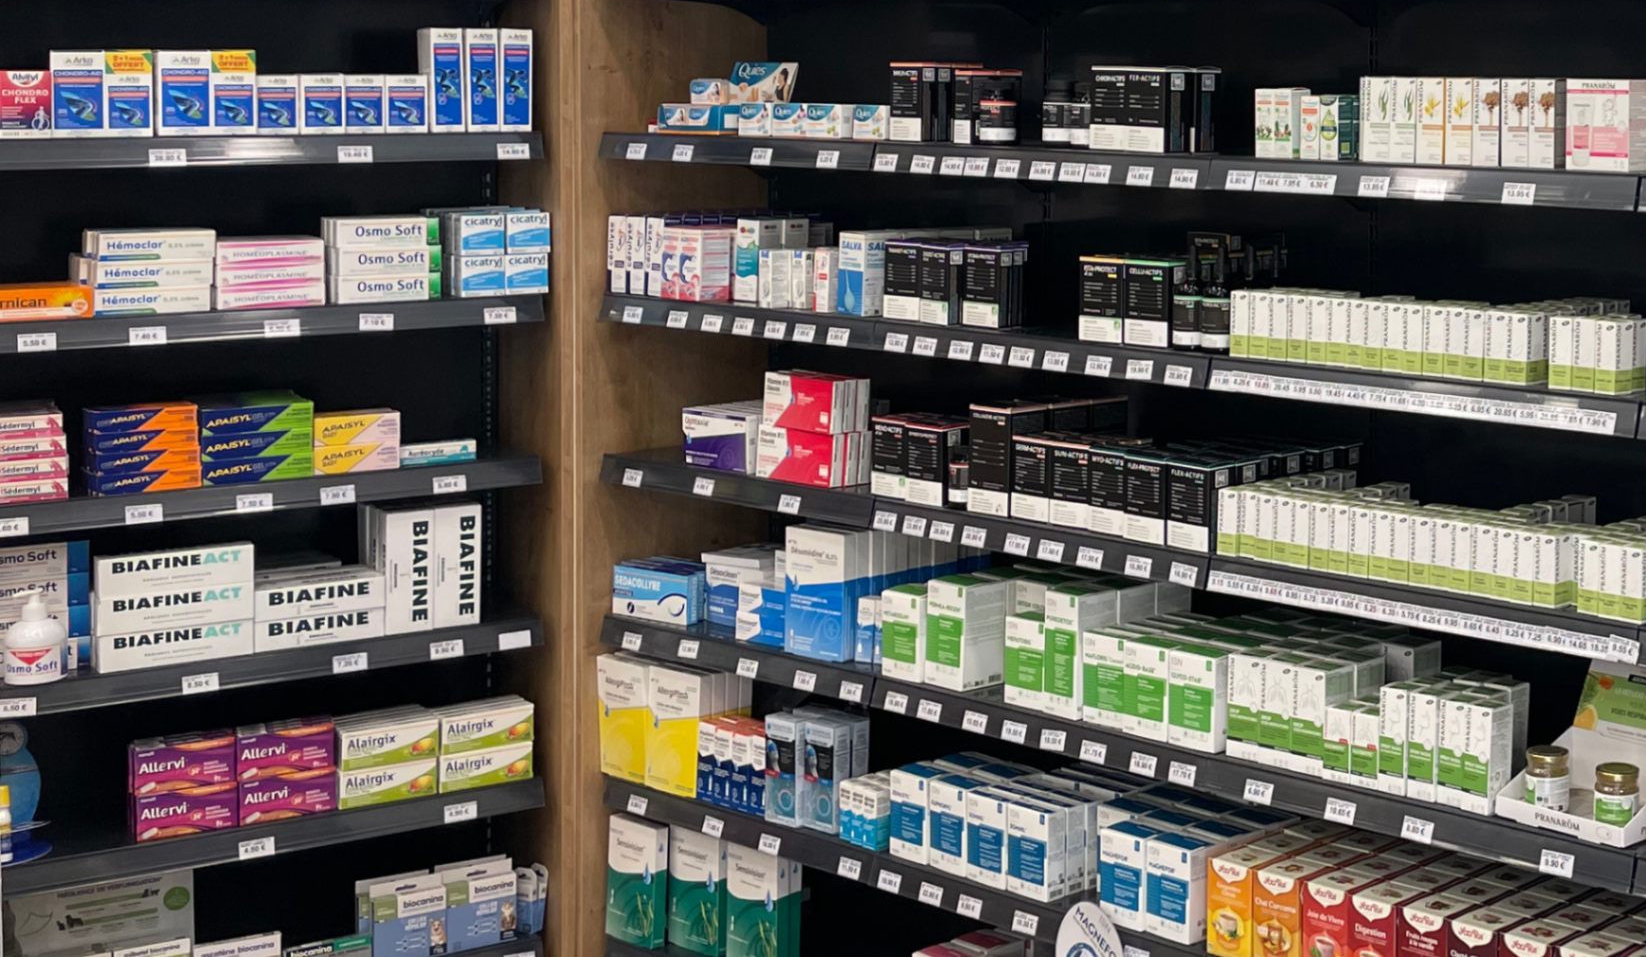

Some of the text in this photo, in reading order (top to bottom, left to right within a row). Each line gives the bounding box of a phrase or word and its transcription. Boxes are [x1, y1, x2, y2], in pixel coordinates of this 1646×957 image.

[355, 224, 422, 237] Osmo Soft
[107, 240, 163, 250] Hémoclar
[357, 279, 424, 292] Osmo Soft
[102, 295, 159, 306] Hémoclar
[207, 414, 251, 428] APAISYL
[207, 464, 252, 478] APAISYL
[412, 520, 429, 623] BIAFINE
[459, 515, 476, 616] BIAFINE
[268, 581, 370, 606] BIAFINE
[268, 611, 369, 637] BIAFINE
[447, 718, 494, 737] Alairgix
[346, 733, 396, 752] Alairgix
[241, 743, 286, 761] Allervi
[139, 758, 186, 776] Allervi
[445, 756, 493, 774] Alairgix
[1534, 811, 1581, 833] PRANARÔM
[474, 881, 514, 894] biocanina
[403, 895, 444, 910] biocanina
